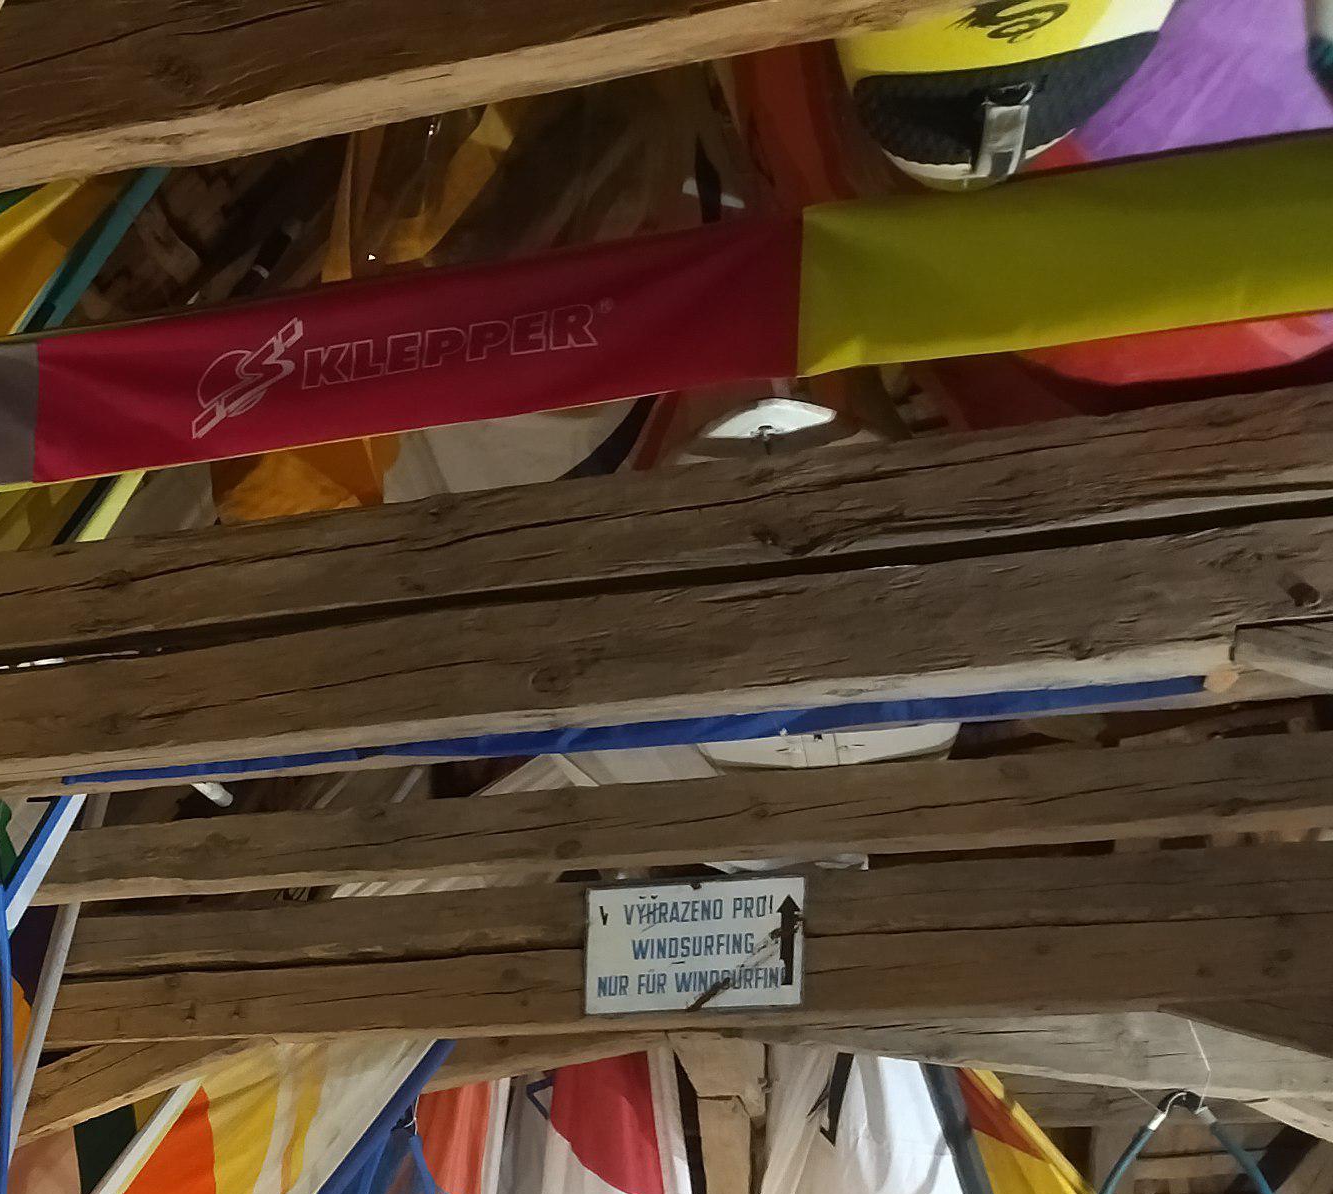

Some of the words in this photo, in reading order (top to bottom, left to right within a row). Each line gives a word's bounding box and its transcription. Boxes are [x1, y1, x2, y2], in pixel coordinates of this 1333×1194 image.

[301, 303, 599, 390] KLEPPER
[632, 933, 755, 960] WINDSURFING
[597, 975, 629, 998] NUR
